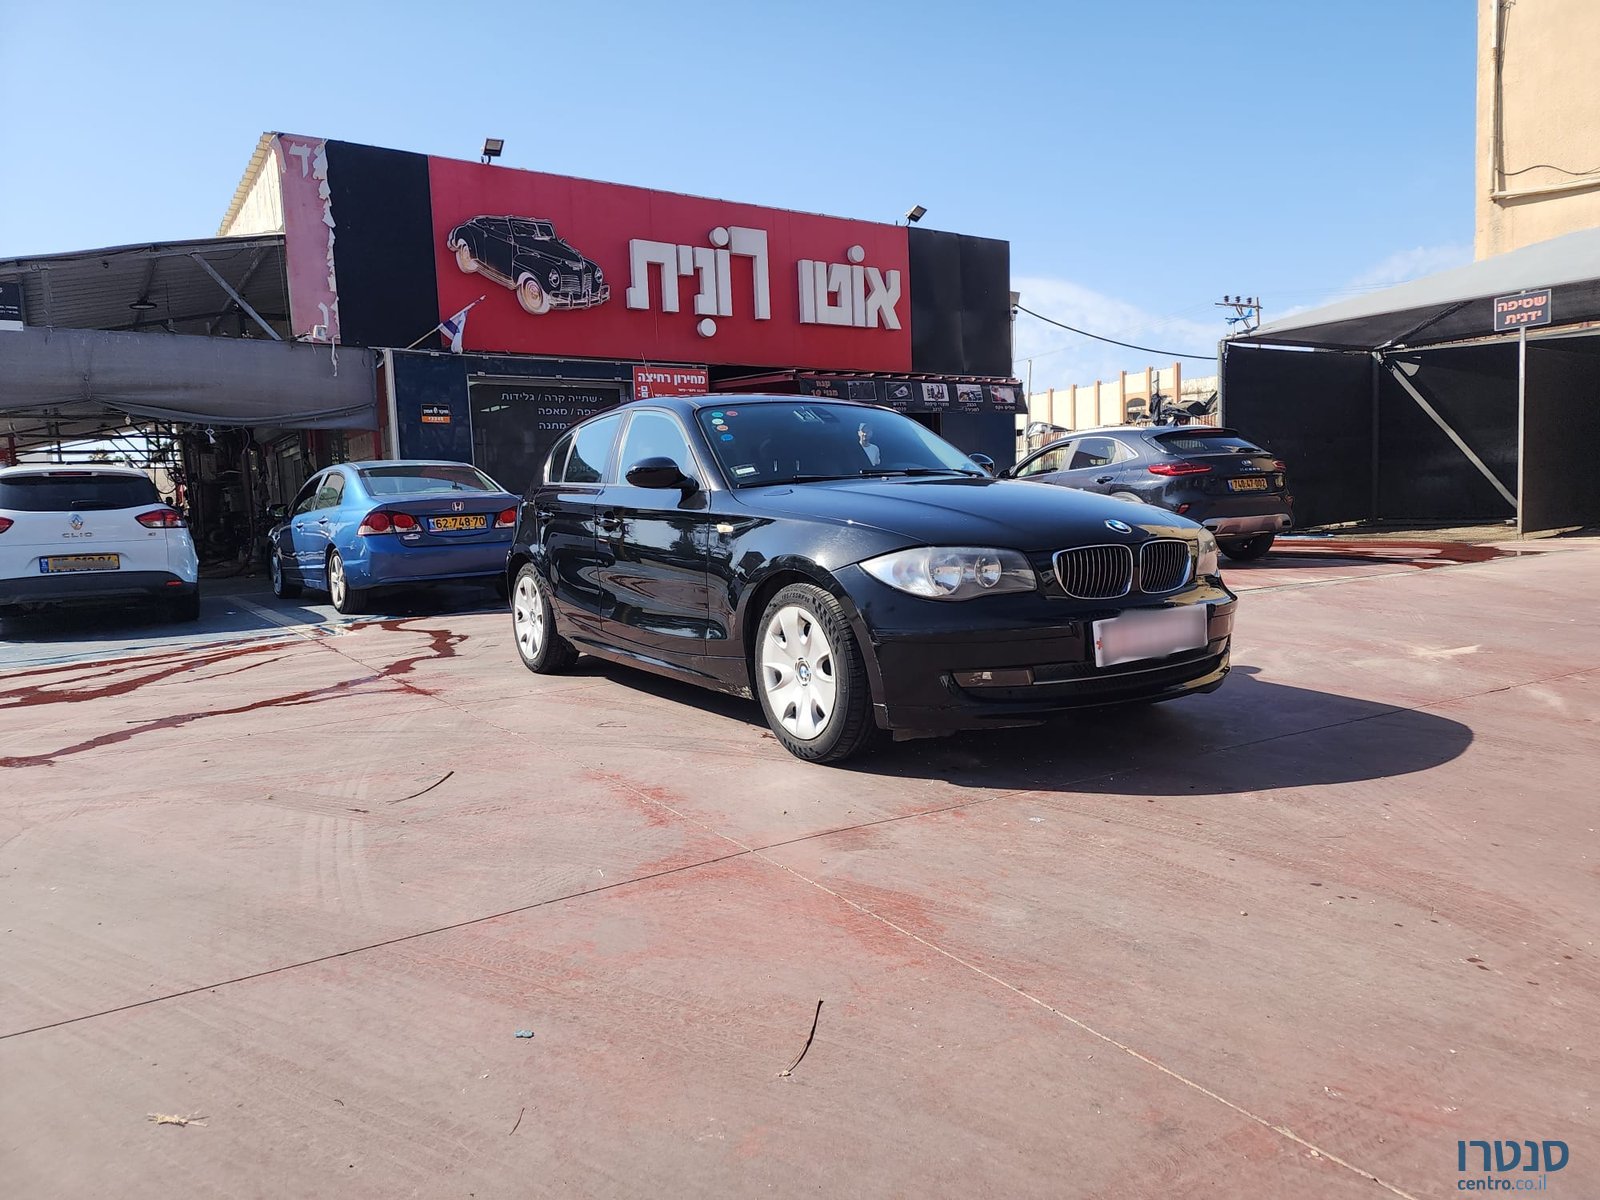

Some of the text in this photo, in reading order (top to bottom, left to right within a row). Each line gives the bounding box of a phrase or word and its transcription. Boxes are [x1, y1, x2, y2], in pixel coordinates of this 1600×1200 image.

[1505, 310, 1543, 325] ידנית
[637, 372, 706, 386] מחירון רחיצה
[501, 392, 535, 401] גלידות
[544, 394, 565, 403] קרה
[538, 407, 568, 415] מאפה
